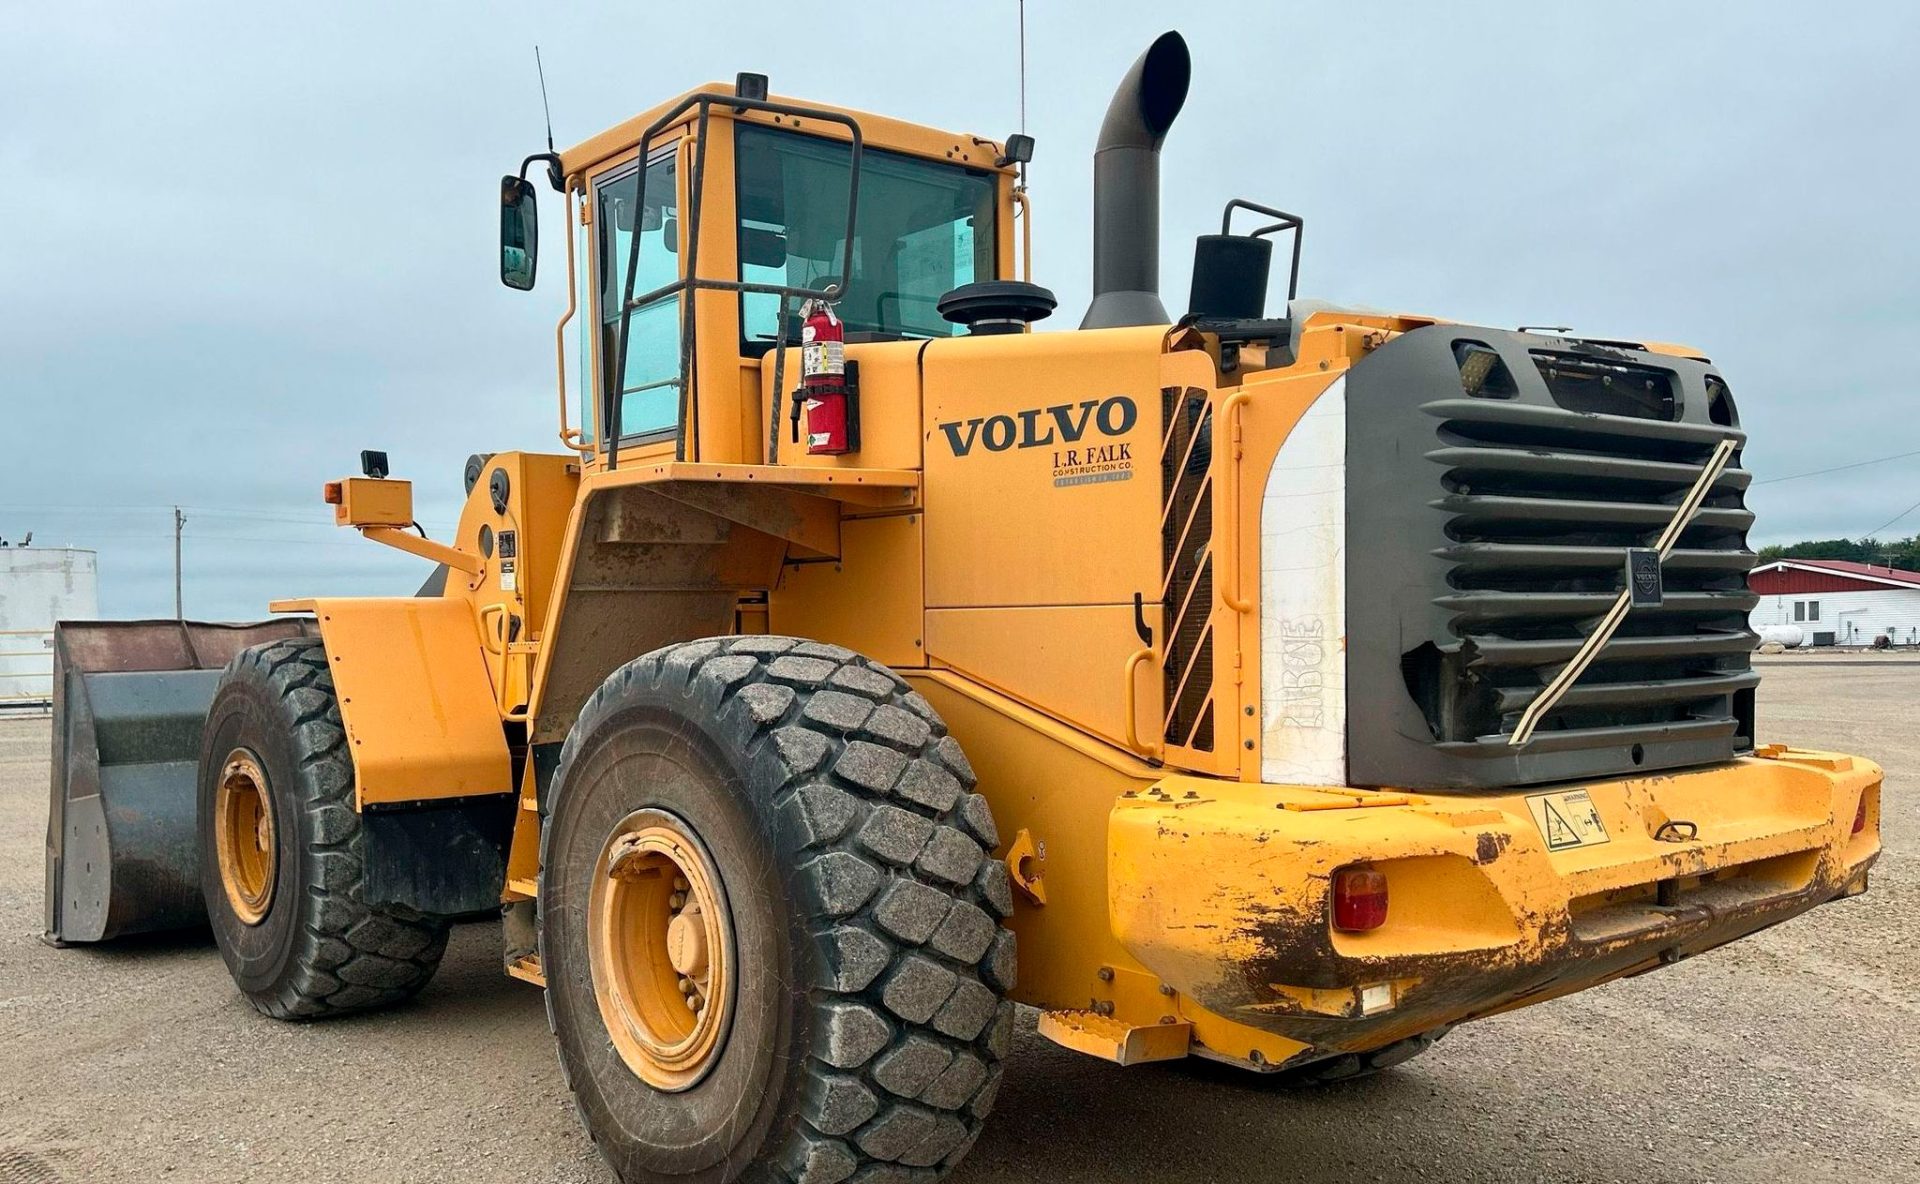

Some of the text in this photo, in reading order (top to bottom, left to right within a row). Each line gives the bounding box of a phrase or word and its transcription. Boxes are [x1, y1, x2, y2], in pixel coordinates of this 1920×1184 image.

[939, 396, 1138, 457] VOLVO
[1086, 442, 1132, 465] FALK
[1052, 464, 1116, 477] CONSTRUCTION
